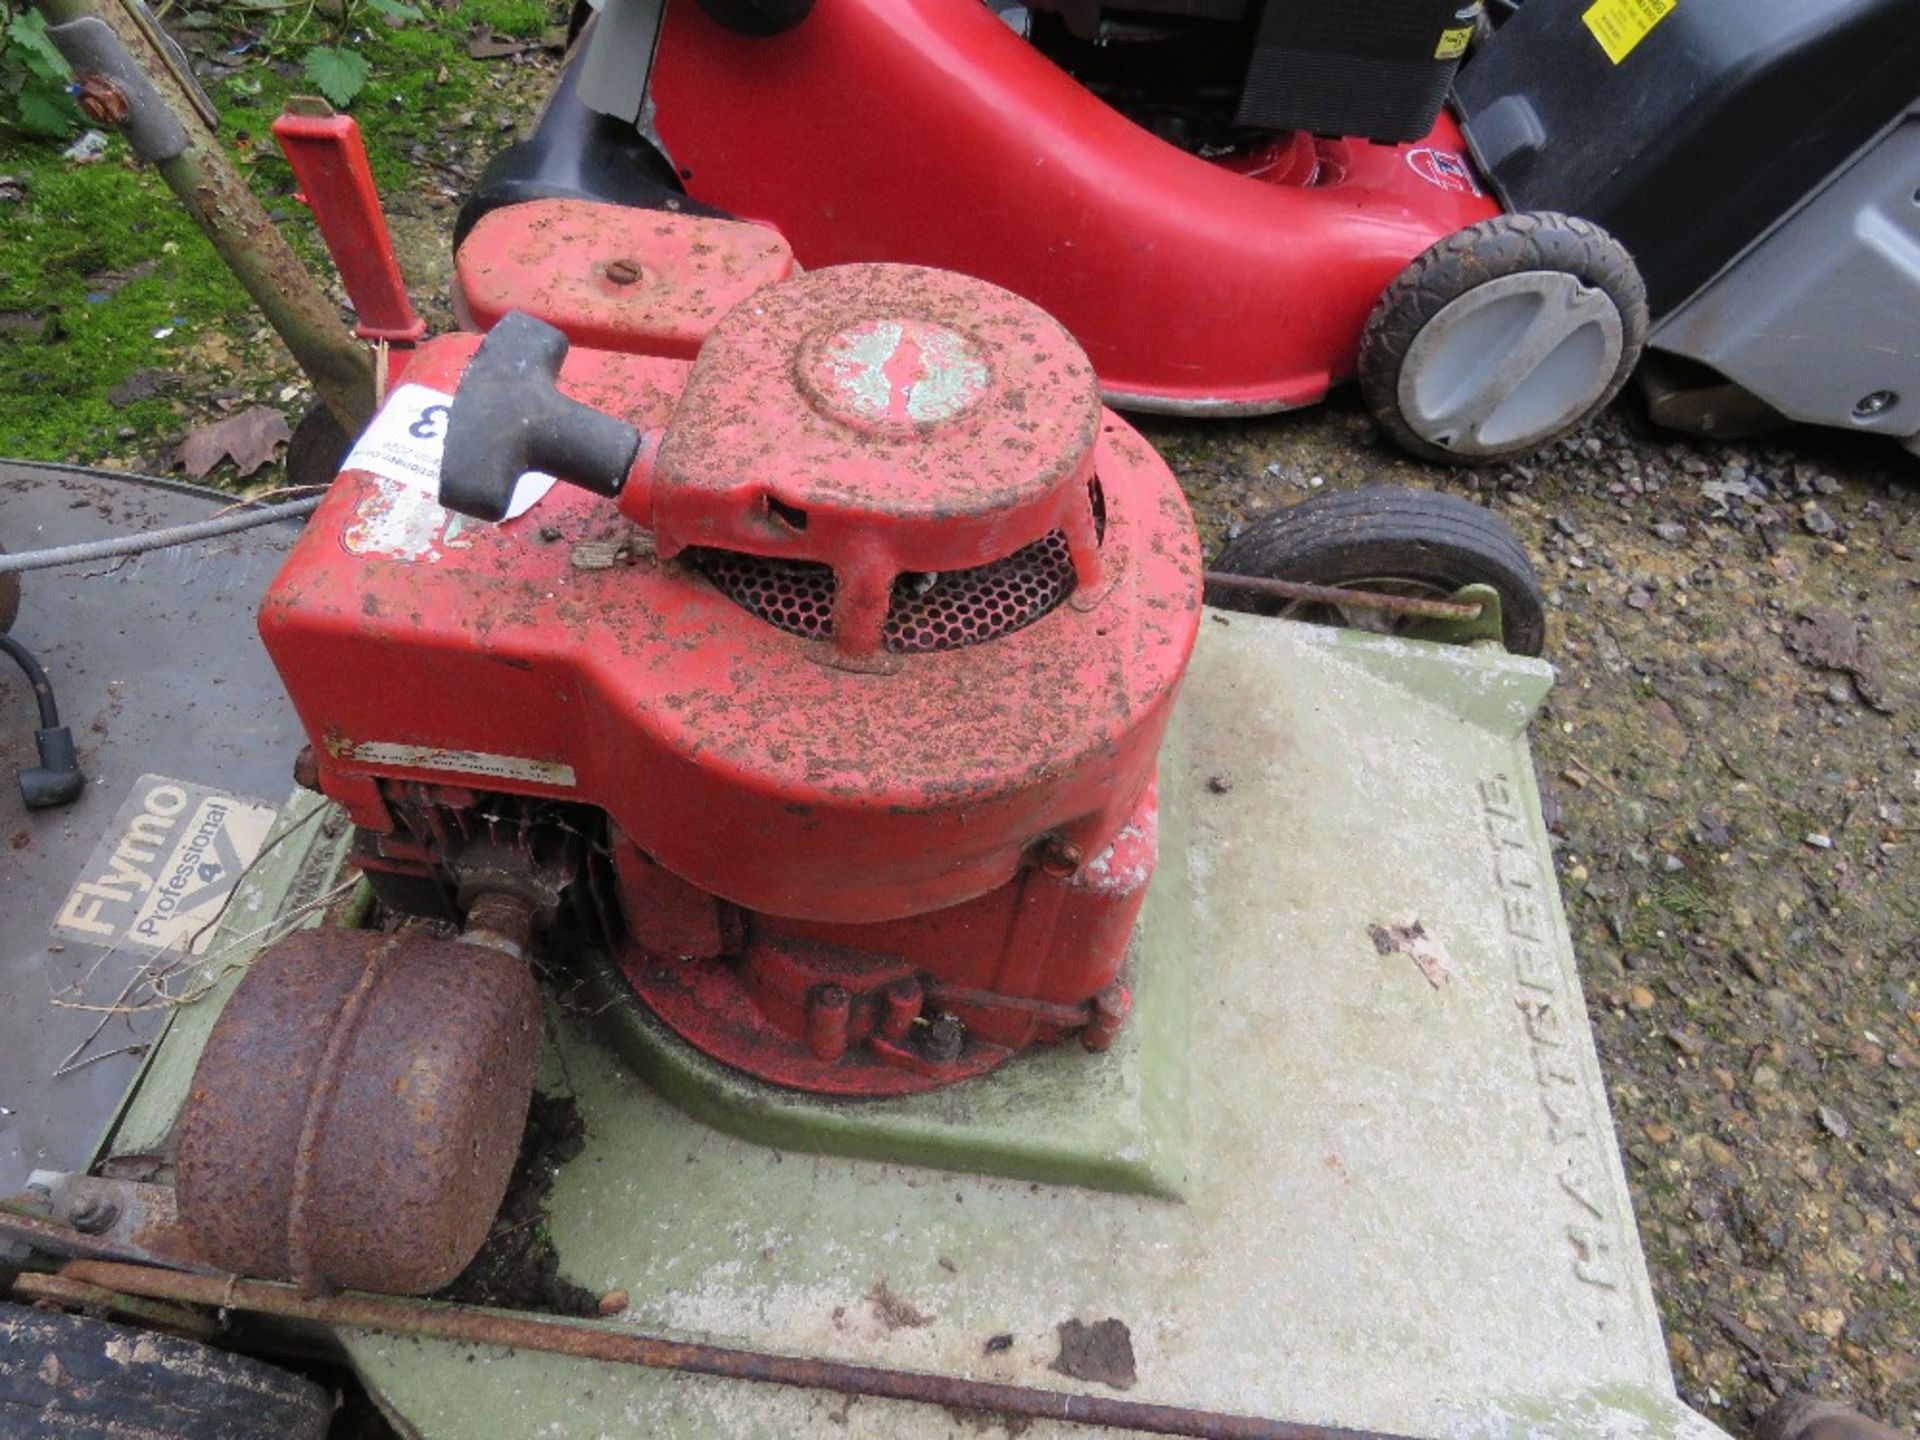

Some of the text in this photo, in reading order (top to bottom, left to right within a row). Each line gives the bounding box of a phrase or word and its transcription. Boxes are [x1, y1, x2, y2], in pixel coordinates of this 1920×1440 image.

[409, 405, 449, 438] 3
[57, 785, 188, 936] Flymo
[137, 803, 229, 937] Professional
